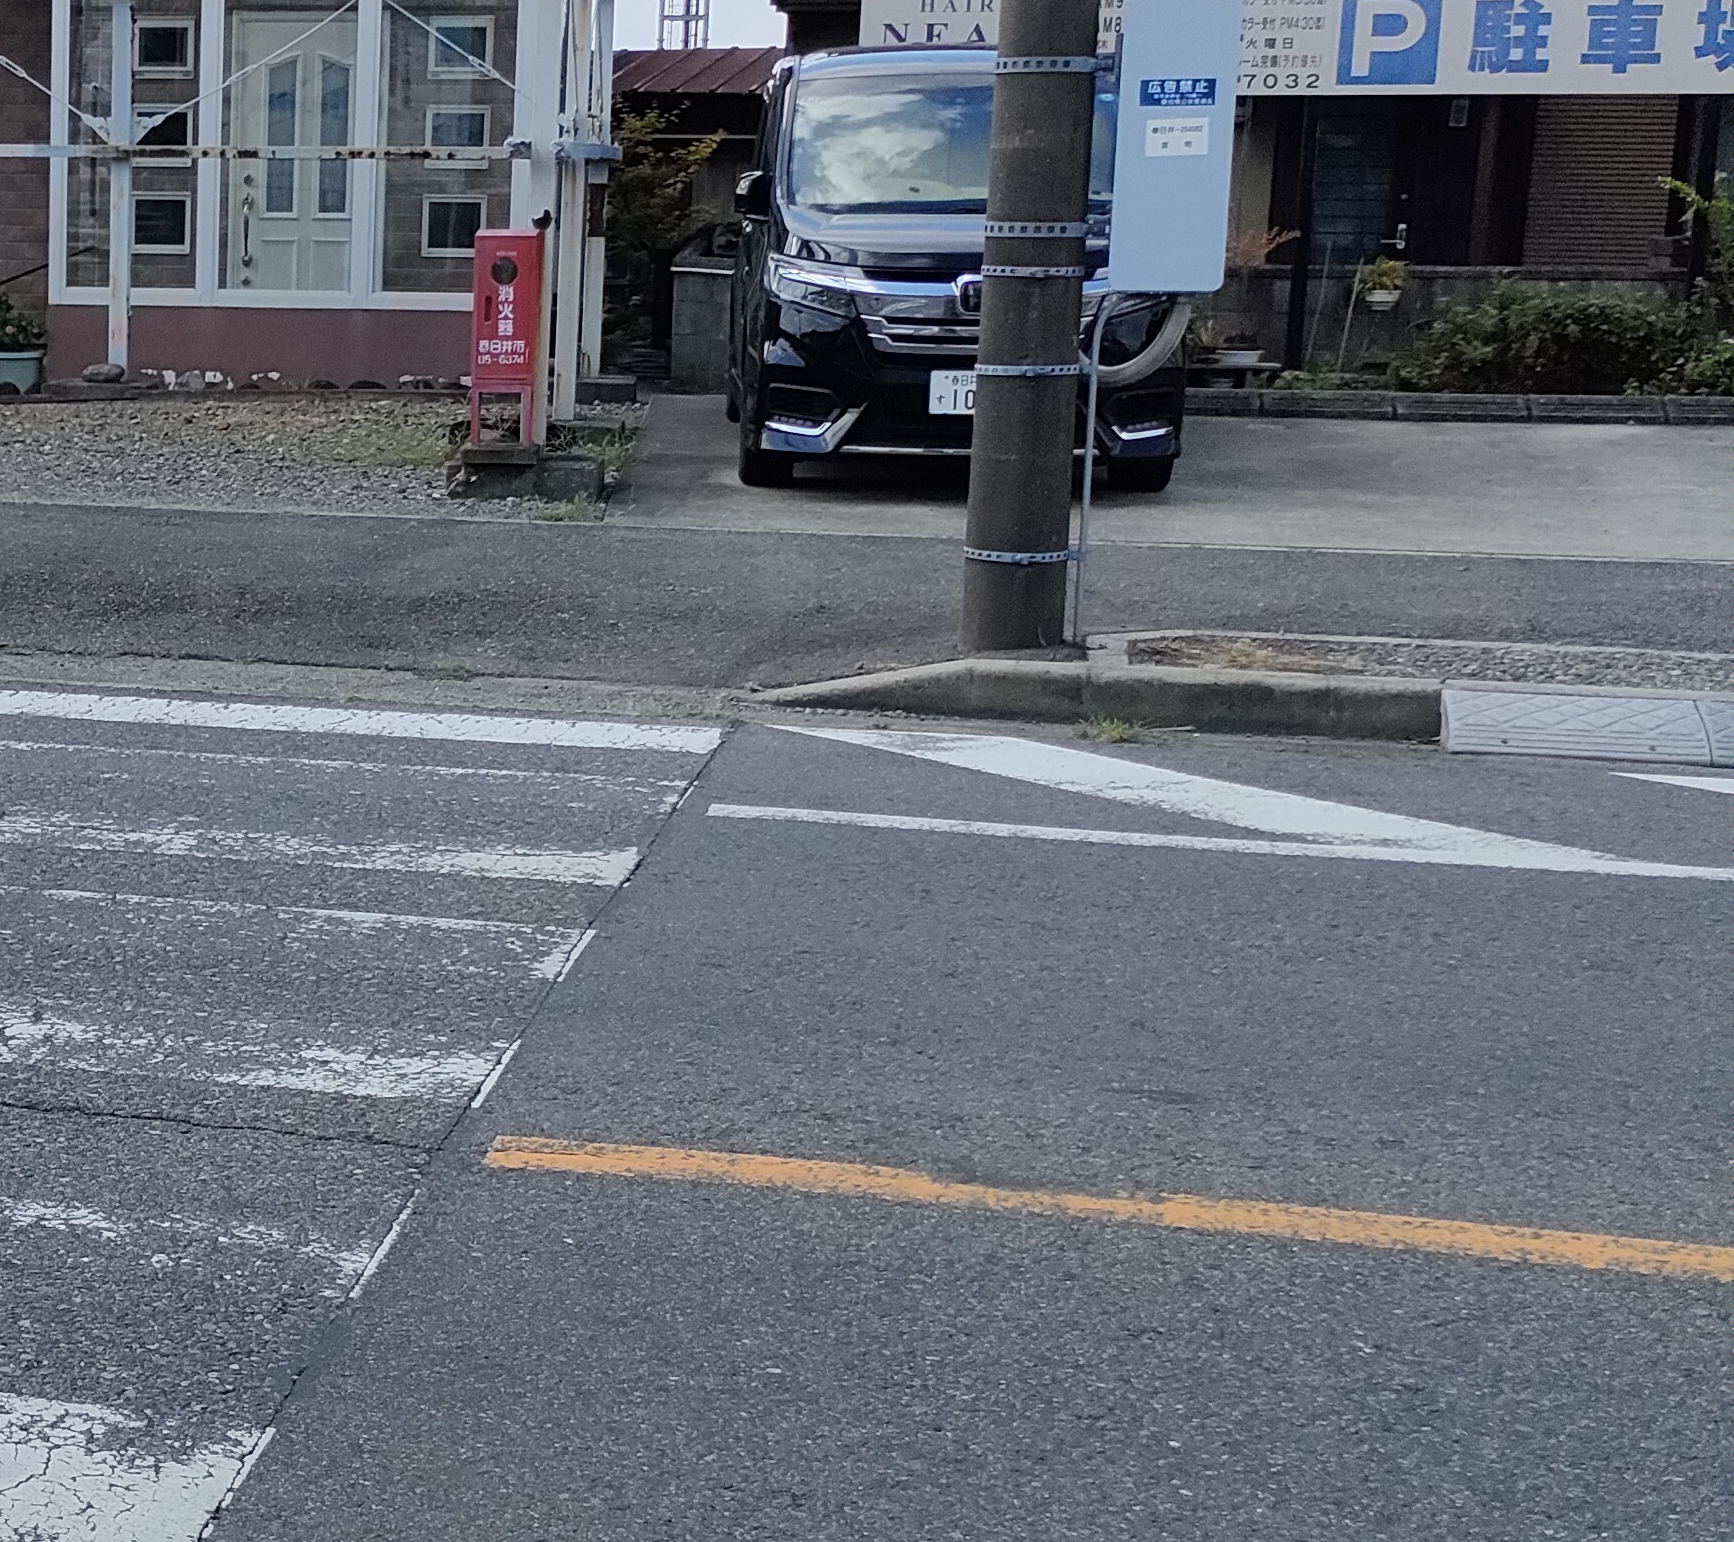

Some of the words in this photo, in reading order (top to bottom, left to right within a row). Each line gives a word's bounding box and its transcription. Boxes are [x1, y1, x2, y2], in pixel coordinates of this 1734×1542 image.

[1351, 0, 1426, 77] P
[1147, 80, 1210, 94] 広告禁止
[497, 285, 515, 336] 消火器
[477, 339, 526, 354] 春日井市
